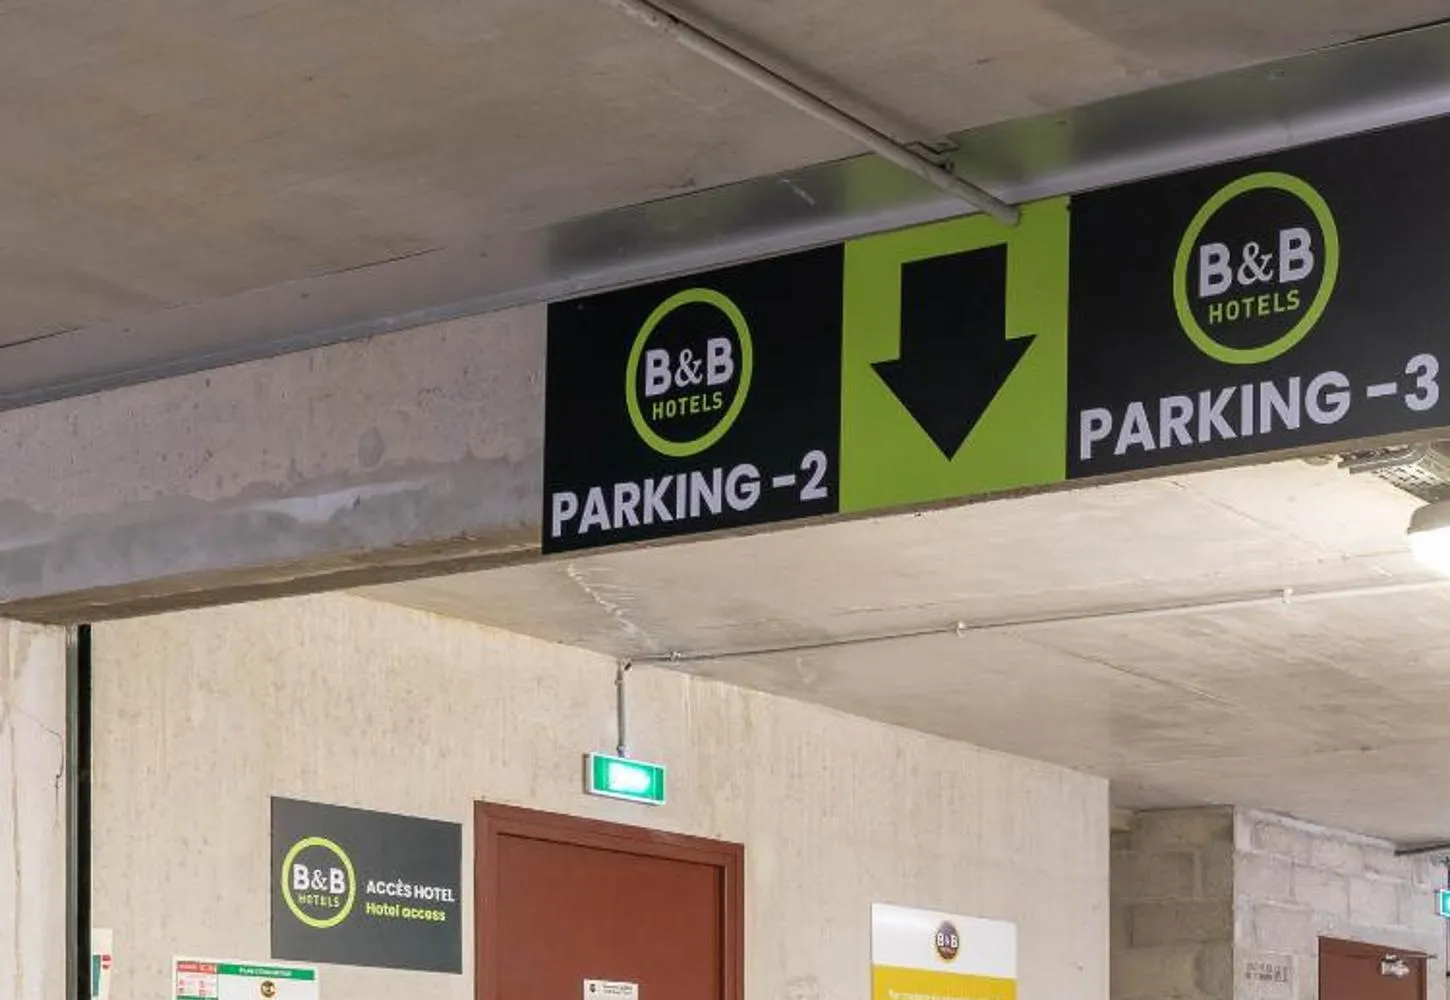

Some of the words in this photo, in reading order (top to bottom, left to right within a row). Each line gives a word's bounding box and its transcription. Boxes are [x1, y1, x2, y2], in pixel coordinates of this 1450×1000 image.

[1199, 226, 1315, 298] B&B
[1209, 289, 1301, 325] HOTELS
[644, 337, 735, 398] B&B
[652, 391, 723, 421] HOTELS
[1079, 370, 1350, 461] PARKING
[1366, 353, 1440, 412] -3
[551, 463, 761, 538] PARKING
[772, 450, 829, 501] -2
[292, 863, 346, 895] B&B
[366, 878, 412, 899] ACCÈS
[414, 885, 456, 903] HOTEL
[365, 901, 400, 918] Hotel
[402, 908, 447, 922] access
